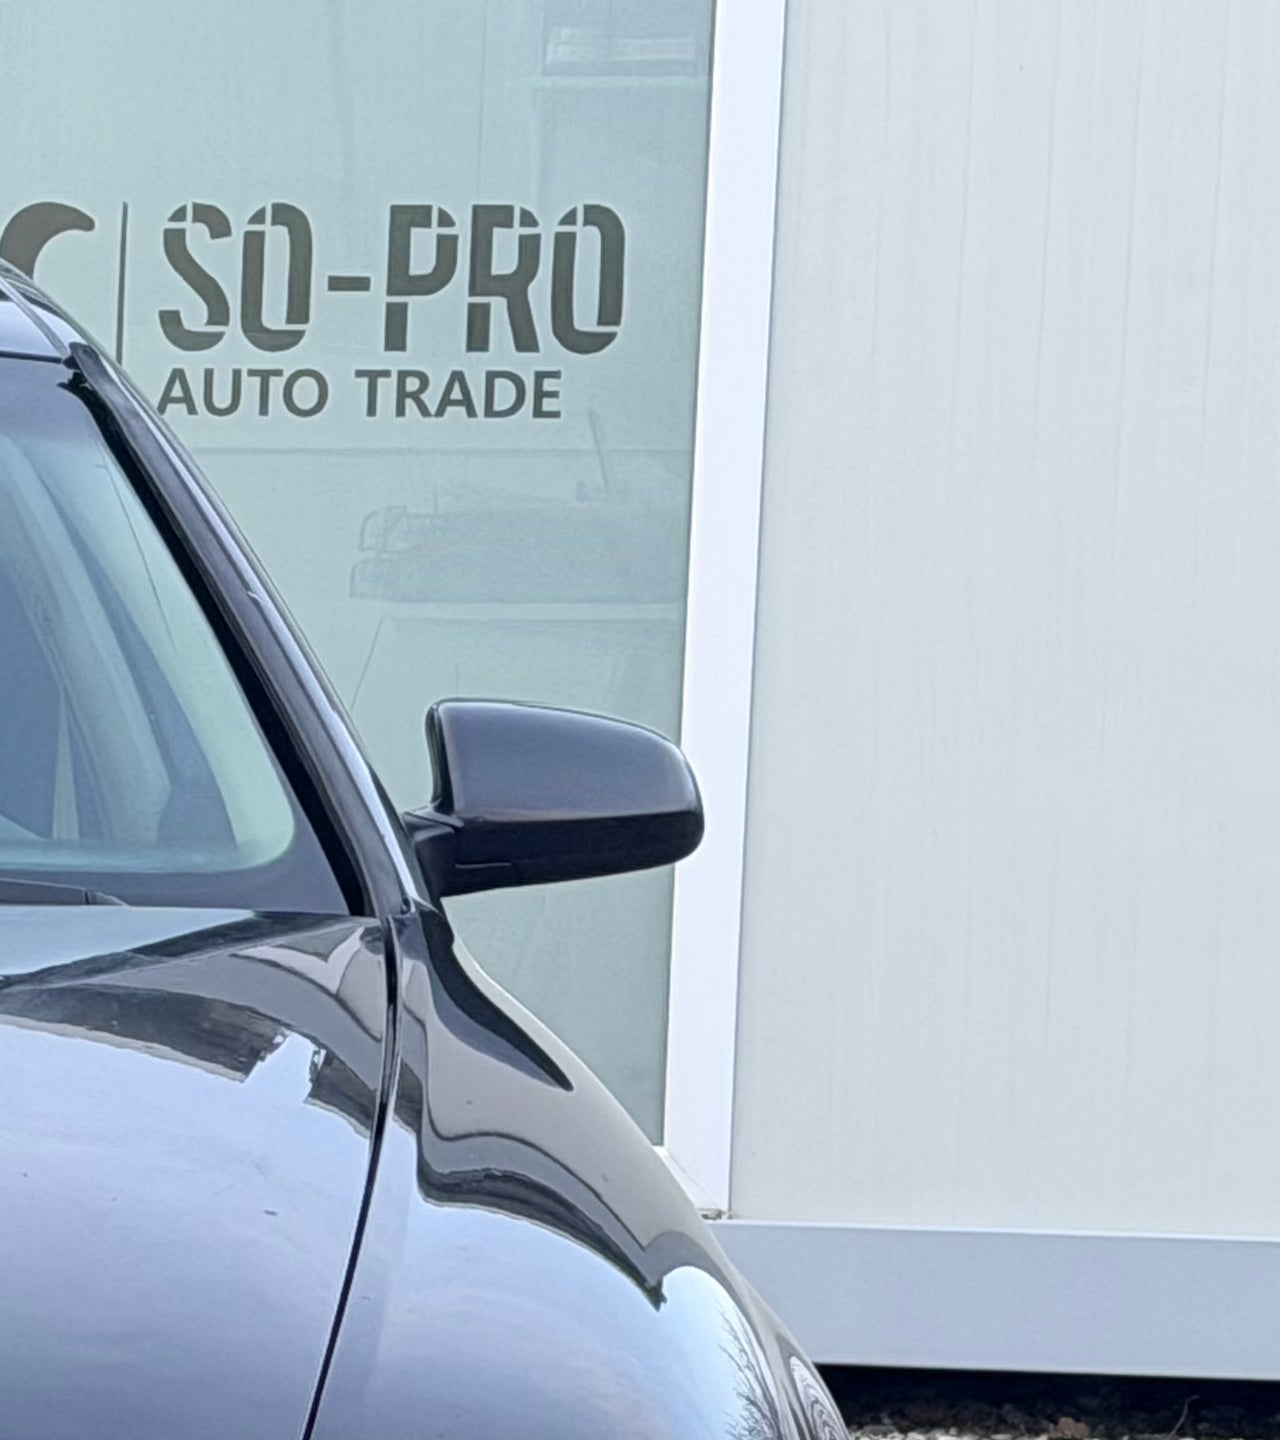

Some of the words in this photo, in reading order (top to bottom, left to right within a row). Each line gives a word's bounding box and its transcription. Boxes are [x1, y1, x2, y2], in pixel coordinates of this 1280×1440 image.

[158, 201, 626, 356] SO-PRO
[156, 367, 329, 418] AUTO
[354, 369, 562, 419] TRADE
